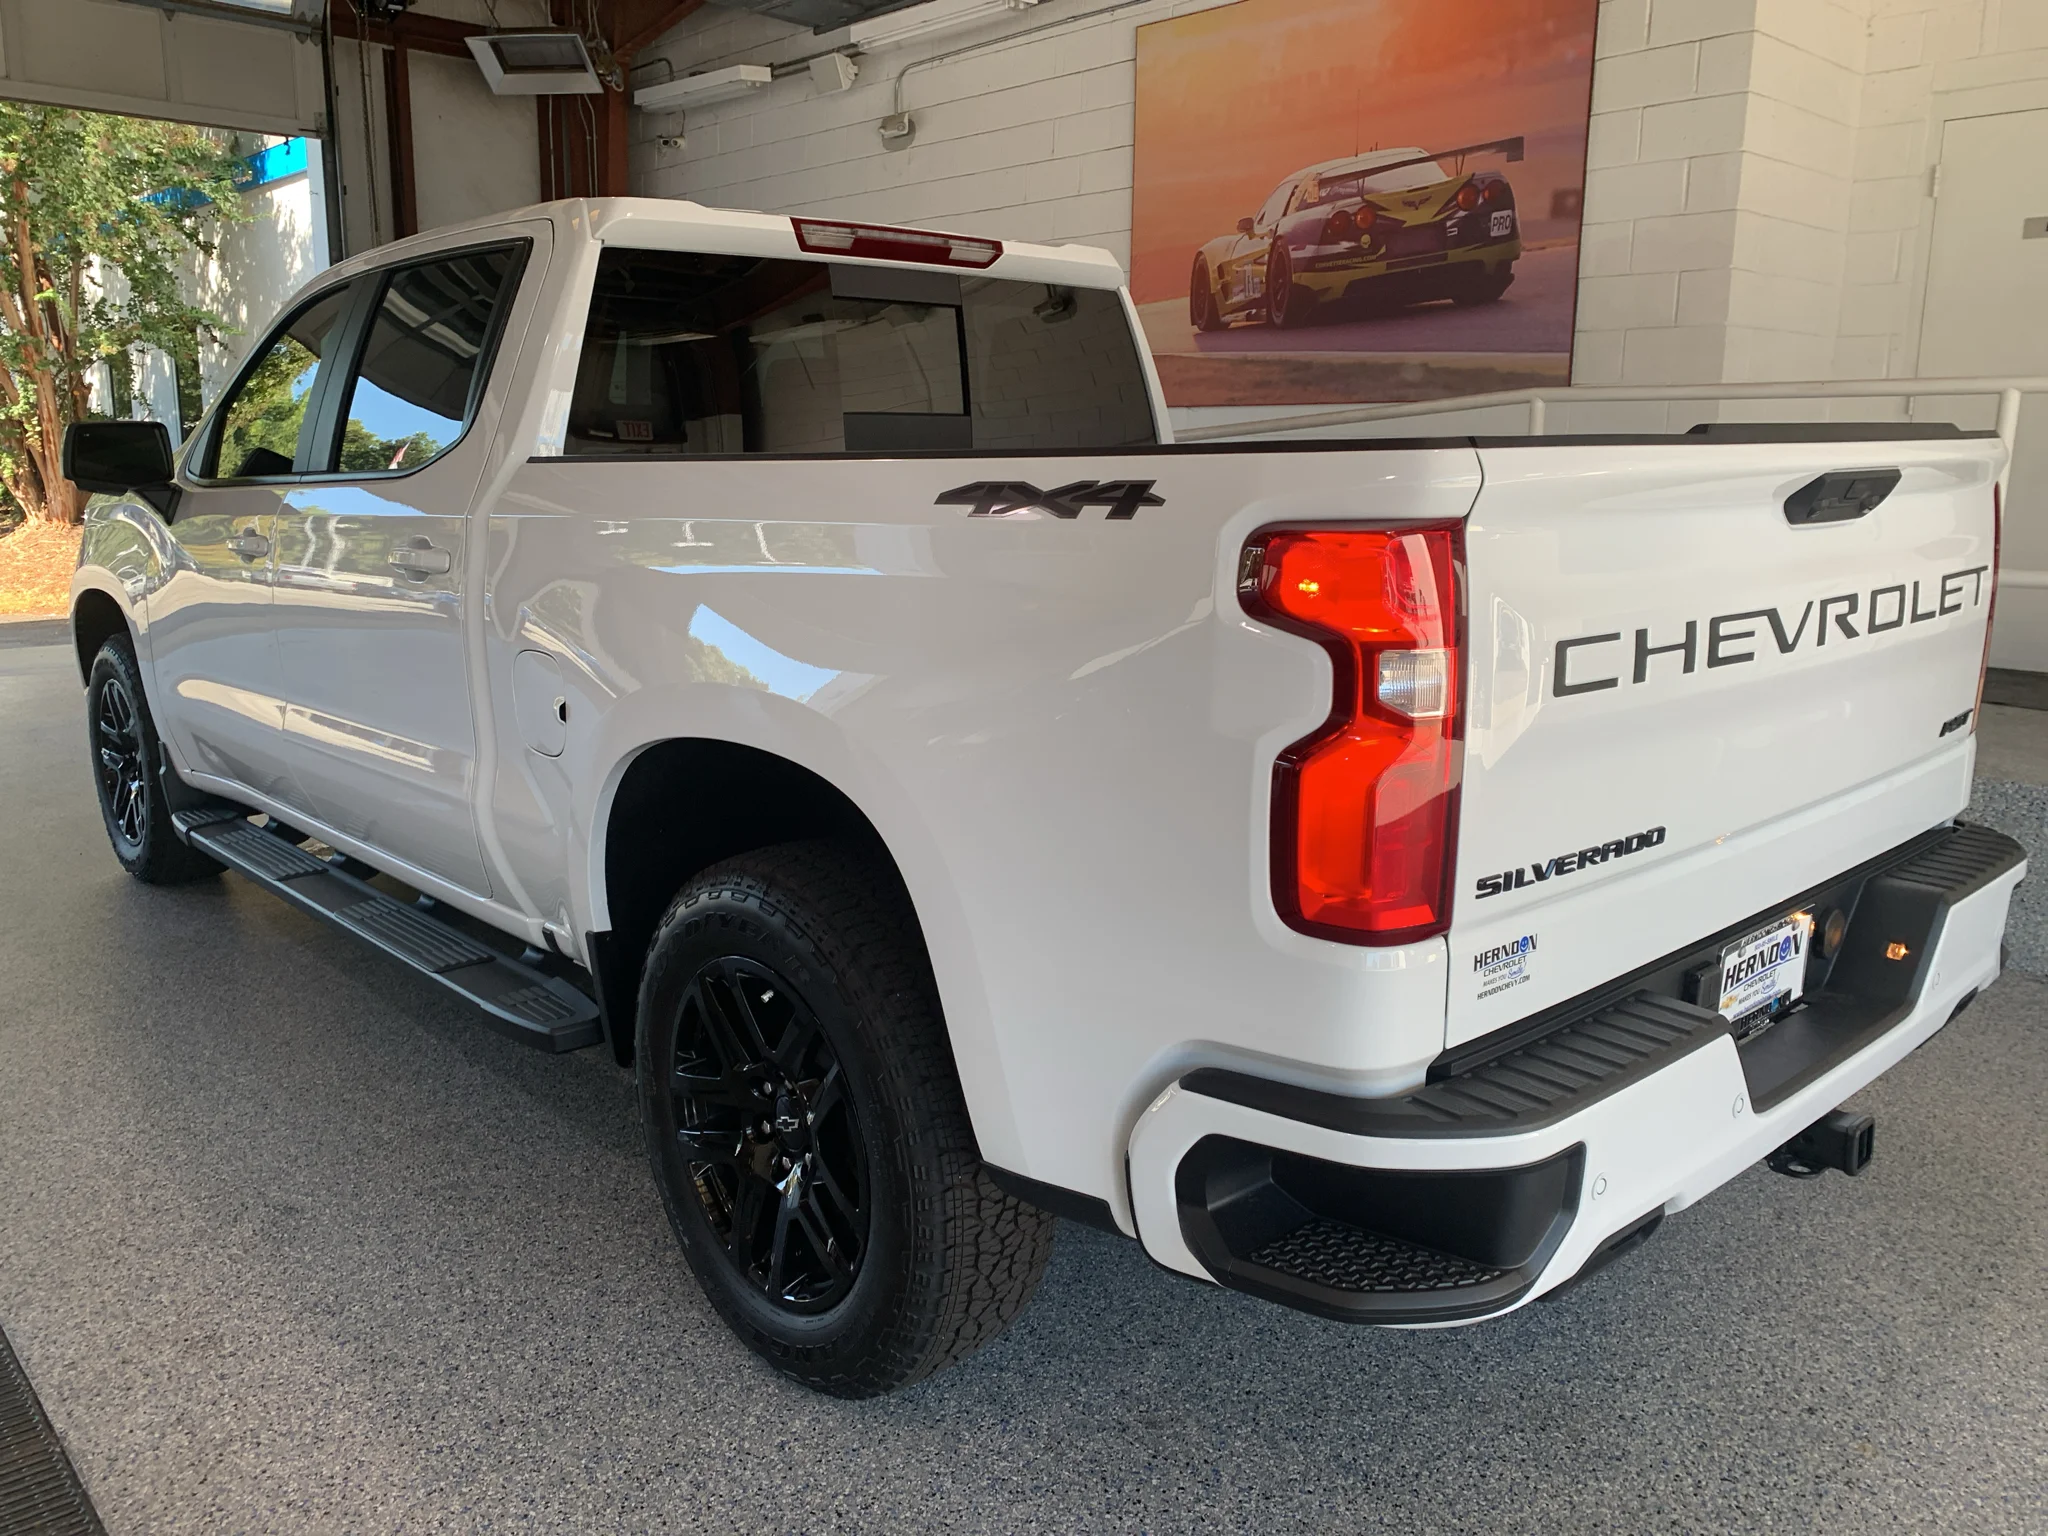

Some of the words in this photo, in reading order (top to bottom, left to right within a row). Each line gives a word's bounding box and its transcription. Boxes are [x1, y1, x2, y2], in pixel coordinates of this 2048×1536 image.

[1492, 215, 1511, 232] PRO
[1553, 565, 1989, 698] CHEVROLET
[1475, 825, 1666, 900] SILVERADO
[1473, 933, 1538, 972] HERNDON
[1483, 955, 1527, 977] CHEVROLET
[1722, 931, 1803, 994] HERNDON
[1476, 974, 1531, 1000] HERNDONCHEVY.COM
[1743, 968, 1777, 992] CHEVROLET
